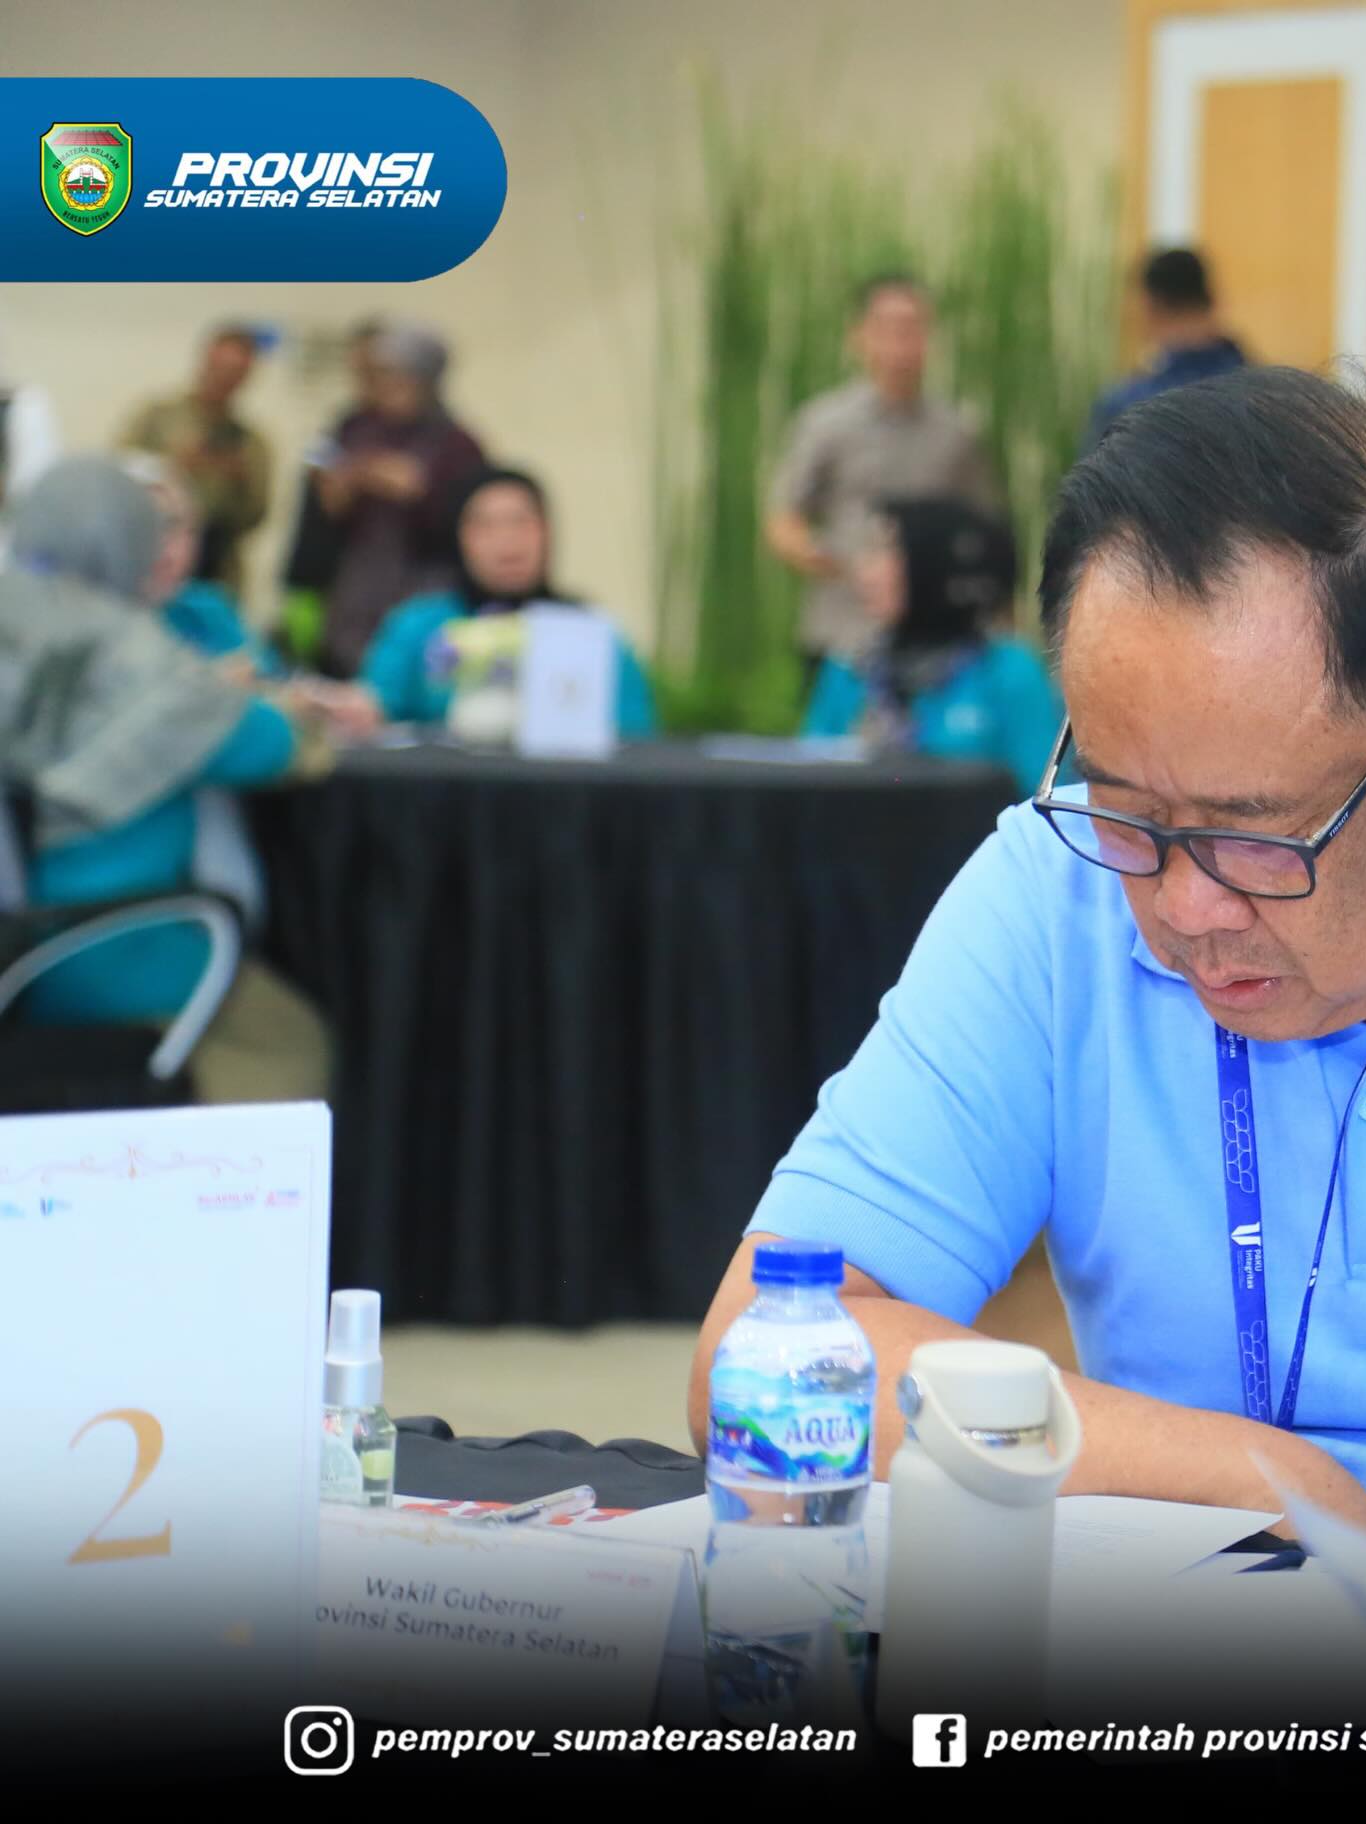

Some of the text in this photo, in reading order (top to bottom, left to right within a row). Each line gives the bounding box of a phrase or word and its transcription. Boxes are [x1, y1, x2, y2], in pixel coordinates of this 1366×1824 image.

[1254, 1248, 1262, 1271] PAKU
[784, 1414, 856, 1447] AQUA
[67, 1407, 172, 1567] 2
[365, 1575, 564, 1624] Wakil Gubernur
[315, 1601, 620, 1662] ovinsi Sumatera Selatan
